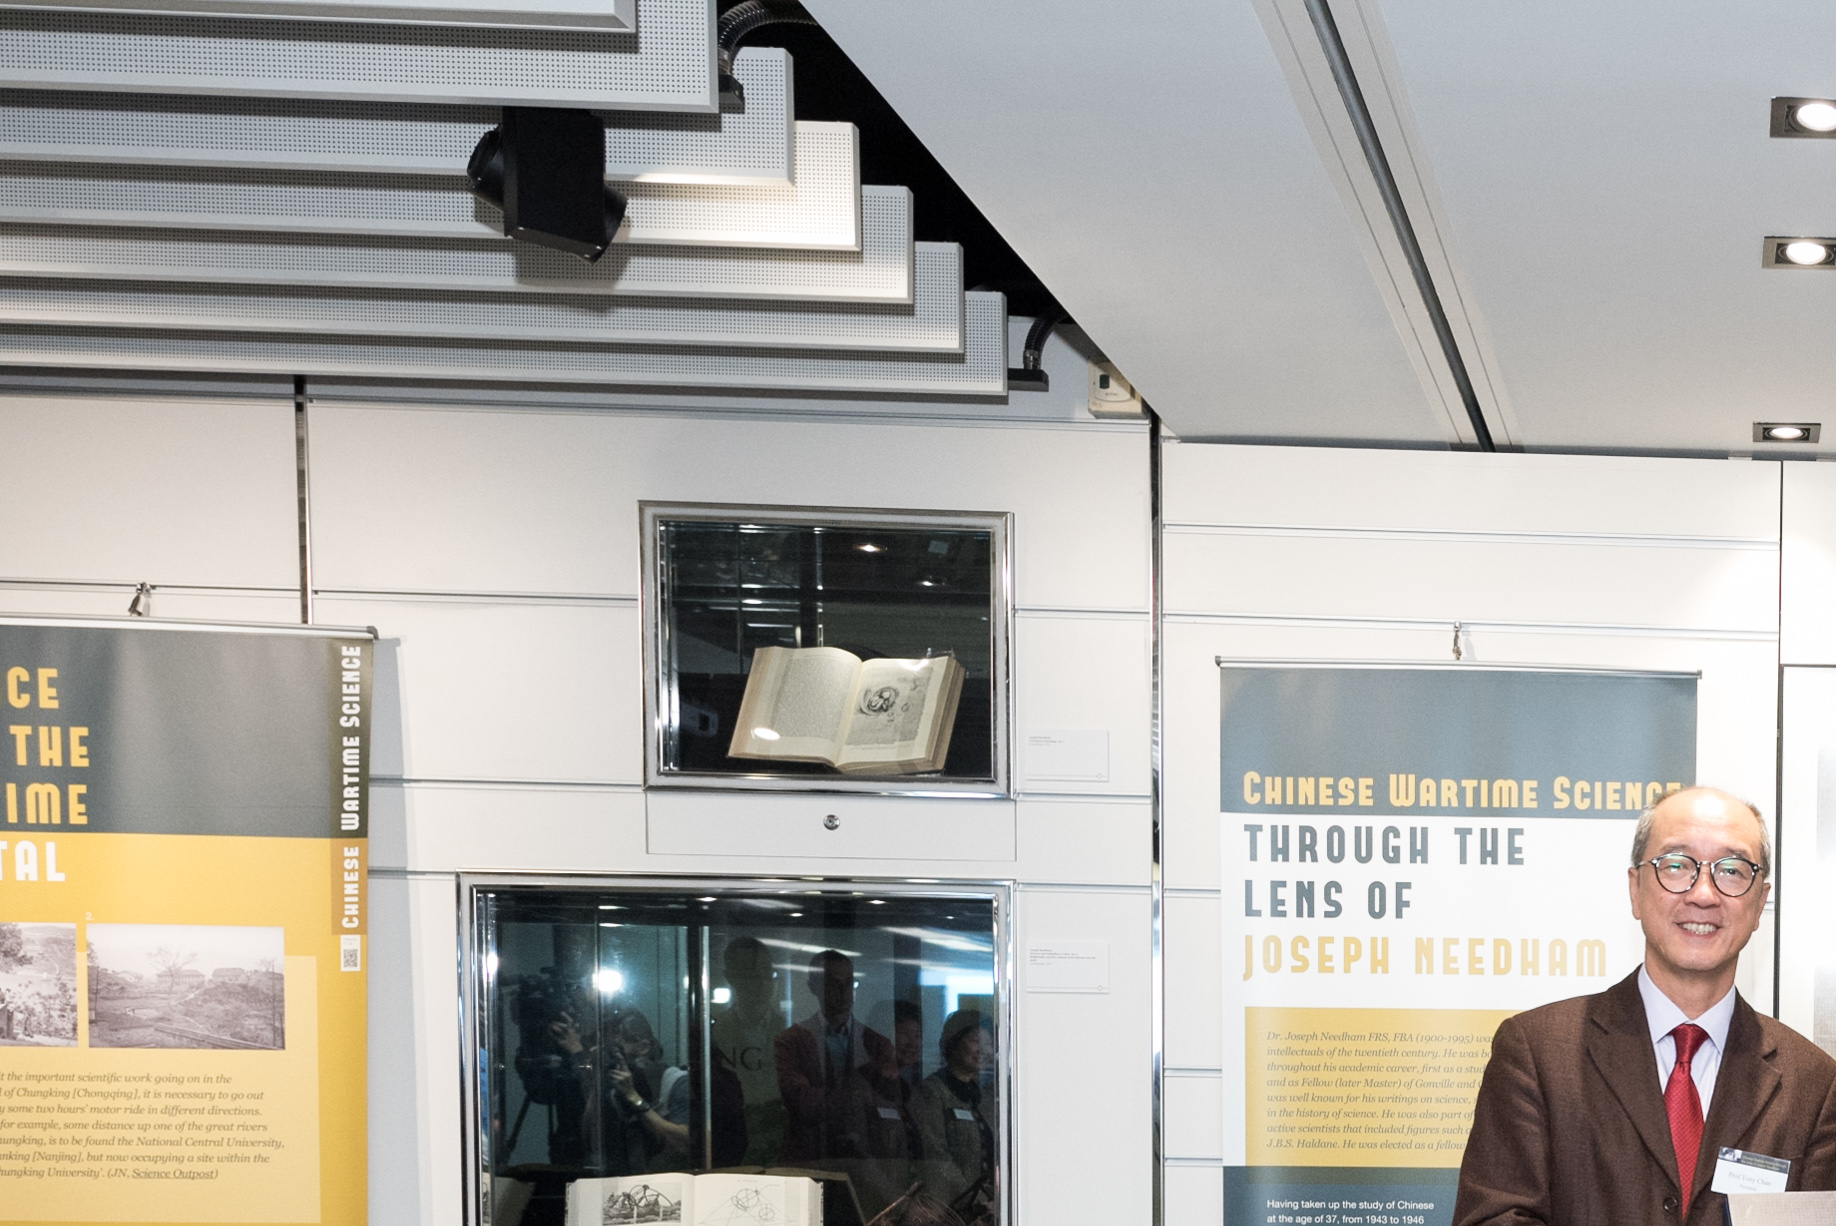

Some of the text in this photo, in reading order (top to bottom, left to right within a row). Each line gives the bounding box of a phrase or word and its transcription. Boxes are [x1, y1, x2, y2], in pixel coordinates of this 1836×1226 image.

[7, 666, 59, 709] CE
[340, 646, 361, 728] SCIENCE
[10, 726, 90, 767] THE
[6, 783, 88, 825] IME
[341, 736, 360, 831] WARTIME
[1243, 771, 1374, 806] CHINESE
[1390, 774, 1538, 809] WARTIME
[1243, 824, 1525, 865] THROUGH THE
[342, 847, 359, 928] CHINESE
[1244, 879, 1413, 919] LENS OF
[1243, 934, 1607, 981] JOSEPH NEEDHAM
[1267, 1031, 1474, 1044] Dr. Joseph Needham FRS, FBA (1900-1995)
[1267, 1046, 1324, 1056] intellectuals
[1326, 1047, 1337, 1059] of
[1338, 1047, 1352, 1057] the
[1355, 1048, 1399, 1057] twentieth
[1401, 1050, 1440, 1059] century.
[1443, 1049, 1457, 1057] He
[3, 1087, 16, 1099] of
[16, 1088, 70, 1100] Chungking
[72, 1088, 140, 1101] [Chongqing],
[143, 1089, 151, 1098] it
[165, 1092, 216, 1101] necessary
[218, 1091, 229, 1099] to
[231, 1093, 244, 1102] go
[246, 1092, 264, 1100] out
[7, 1071, 23, 1081] the
[25, 1072, 75, 1084] important
[78, 1072, 122, 1084] scientific
[124, 1073, 152, 1083] work
[154, 1074, 185, 1085] going
[203, 1074, 213, 1083] in
[216, 1074, 232, 1083] the
[1267, 1200, 1434, 1211] Having taken up the study of Chinese
